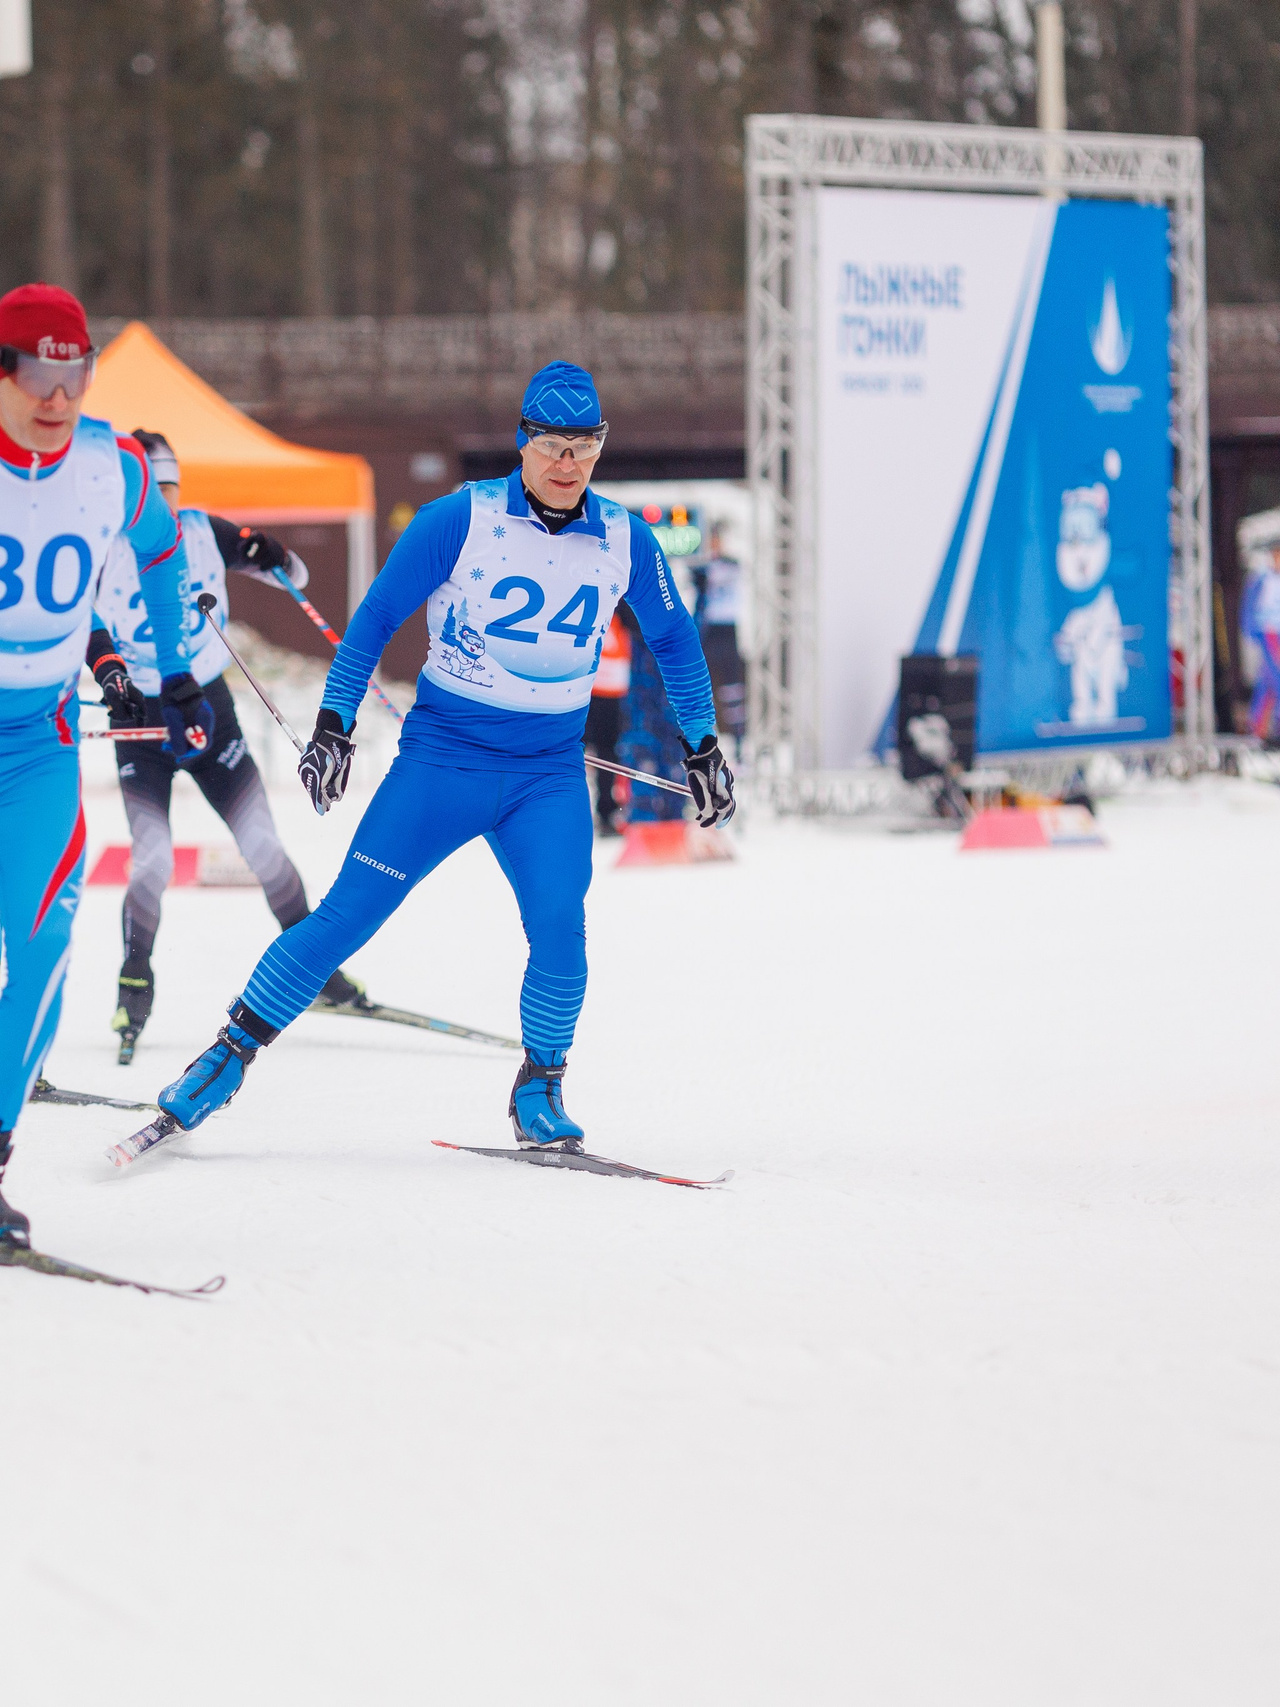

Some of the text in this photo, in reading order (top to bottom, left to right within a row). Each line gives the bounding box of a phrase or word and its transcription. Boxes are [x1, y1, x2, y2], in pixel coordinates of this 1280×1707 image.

[543, 510, 562, 519] CRAFT
[655, 551, 675, 611] noname
[484, 575, 599, 647] 24
[352, 851, 407, 881] noname
